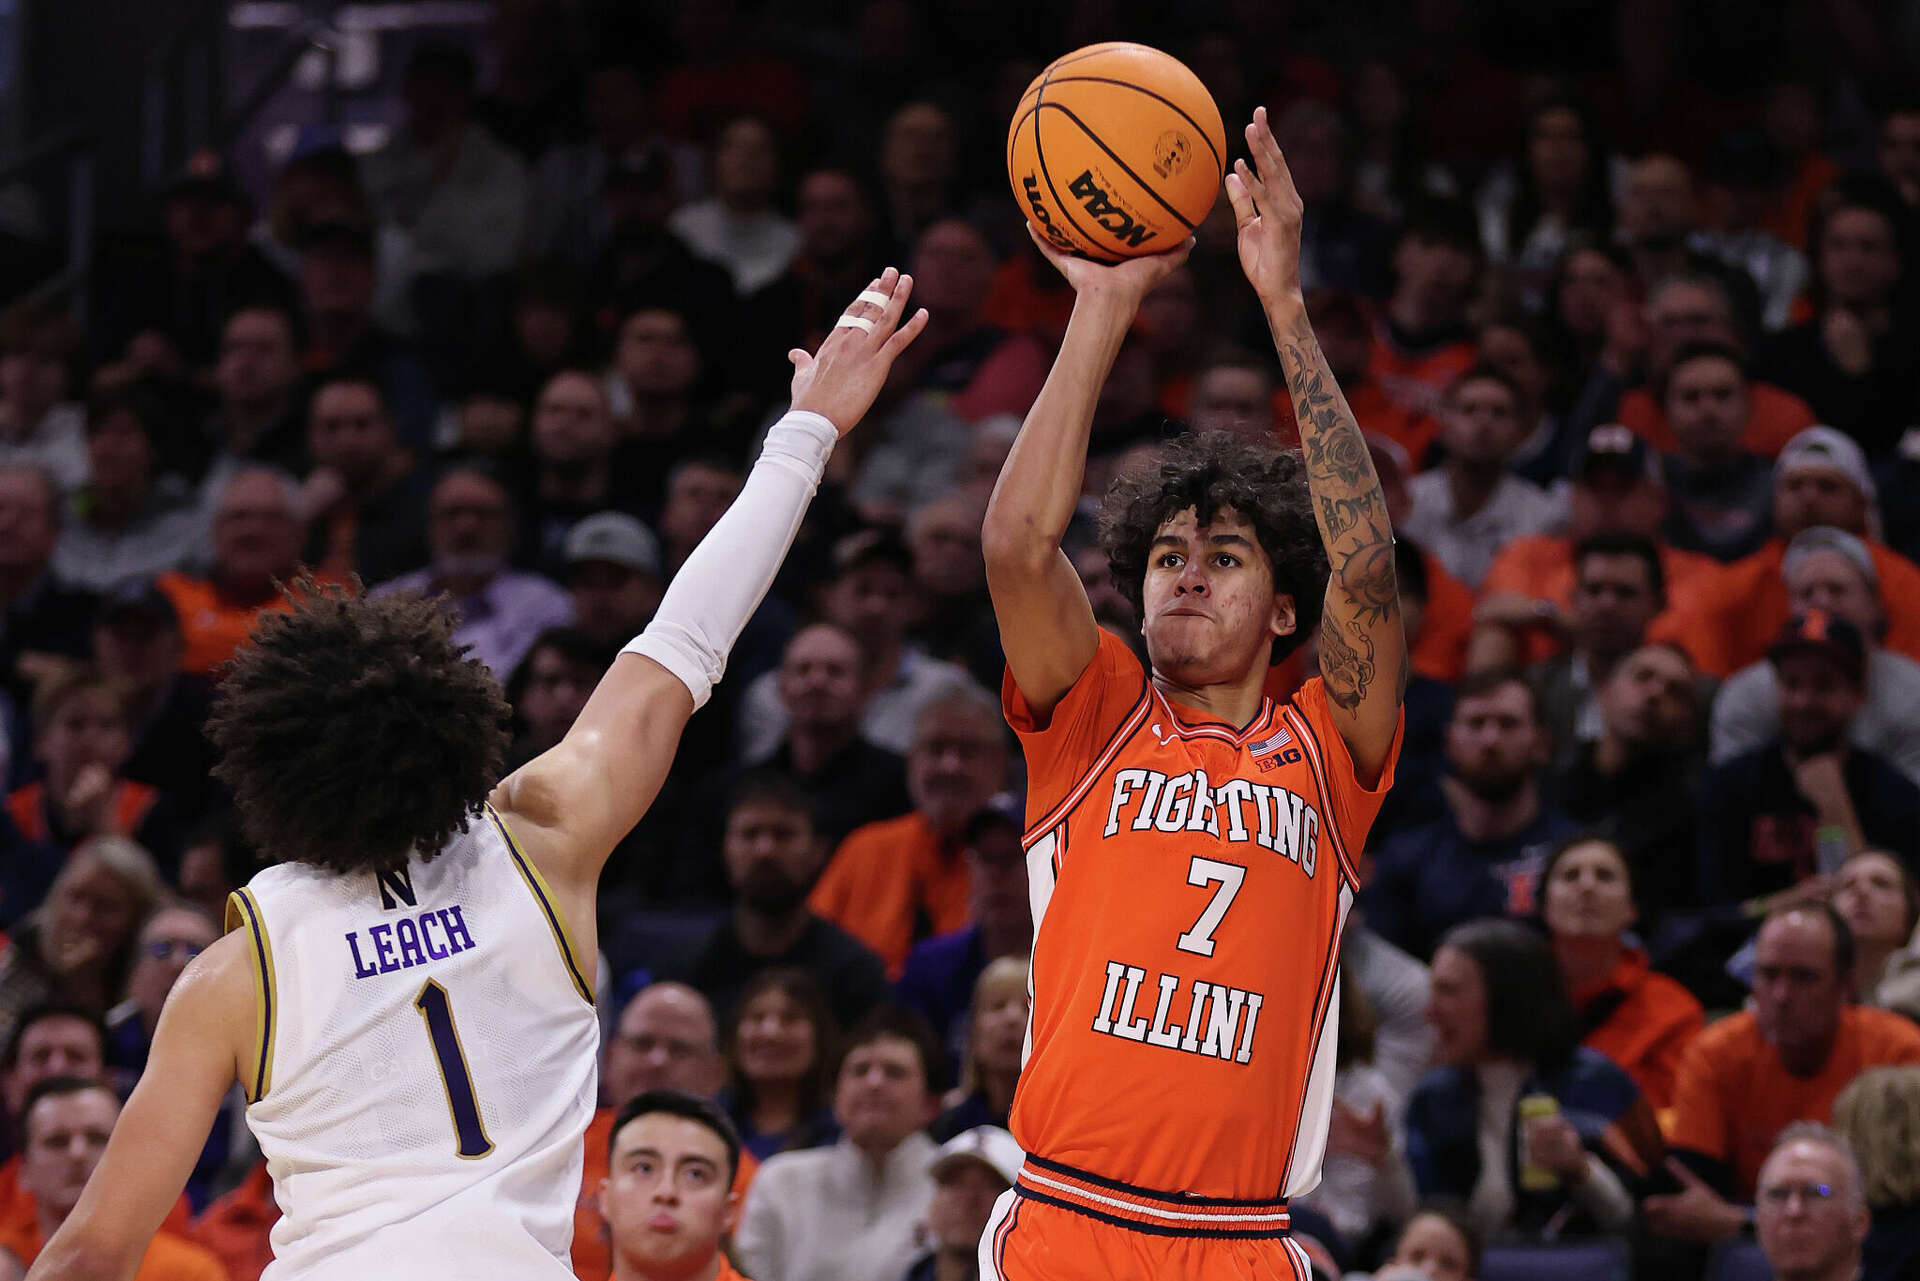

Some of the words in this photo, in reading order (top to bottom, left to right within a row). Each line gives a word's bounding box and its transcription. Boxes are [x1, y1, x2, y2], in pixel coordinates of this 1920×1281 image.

[1067, 169, 1157, 248] NCAA
[1103, 768, 1319, 880] FIGHTING
[345, 905, 477, 980] LEACH
[1176, 856, 1247, 957] 7
[1091, 960, 1264, 1065] ILLINI
[413, 976, 497, 1160] 1
